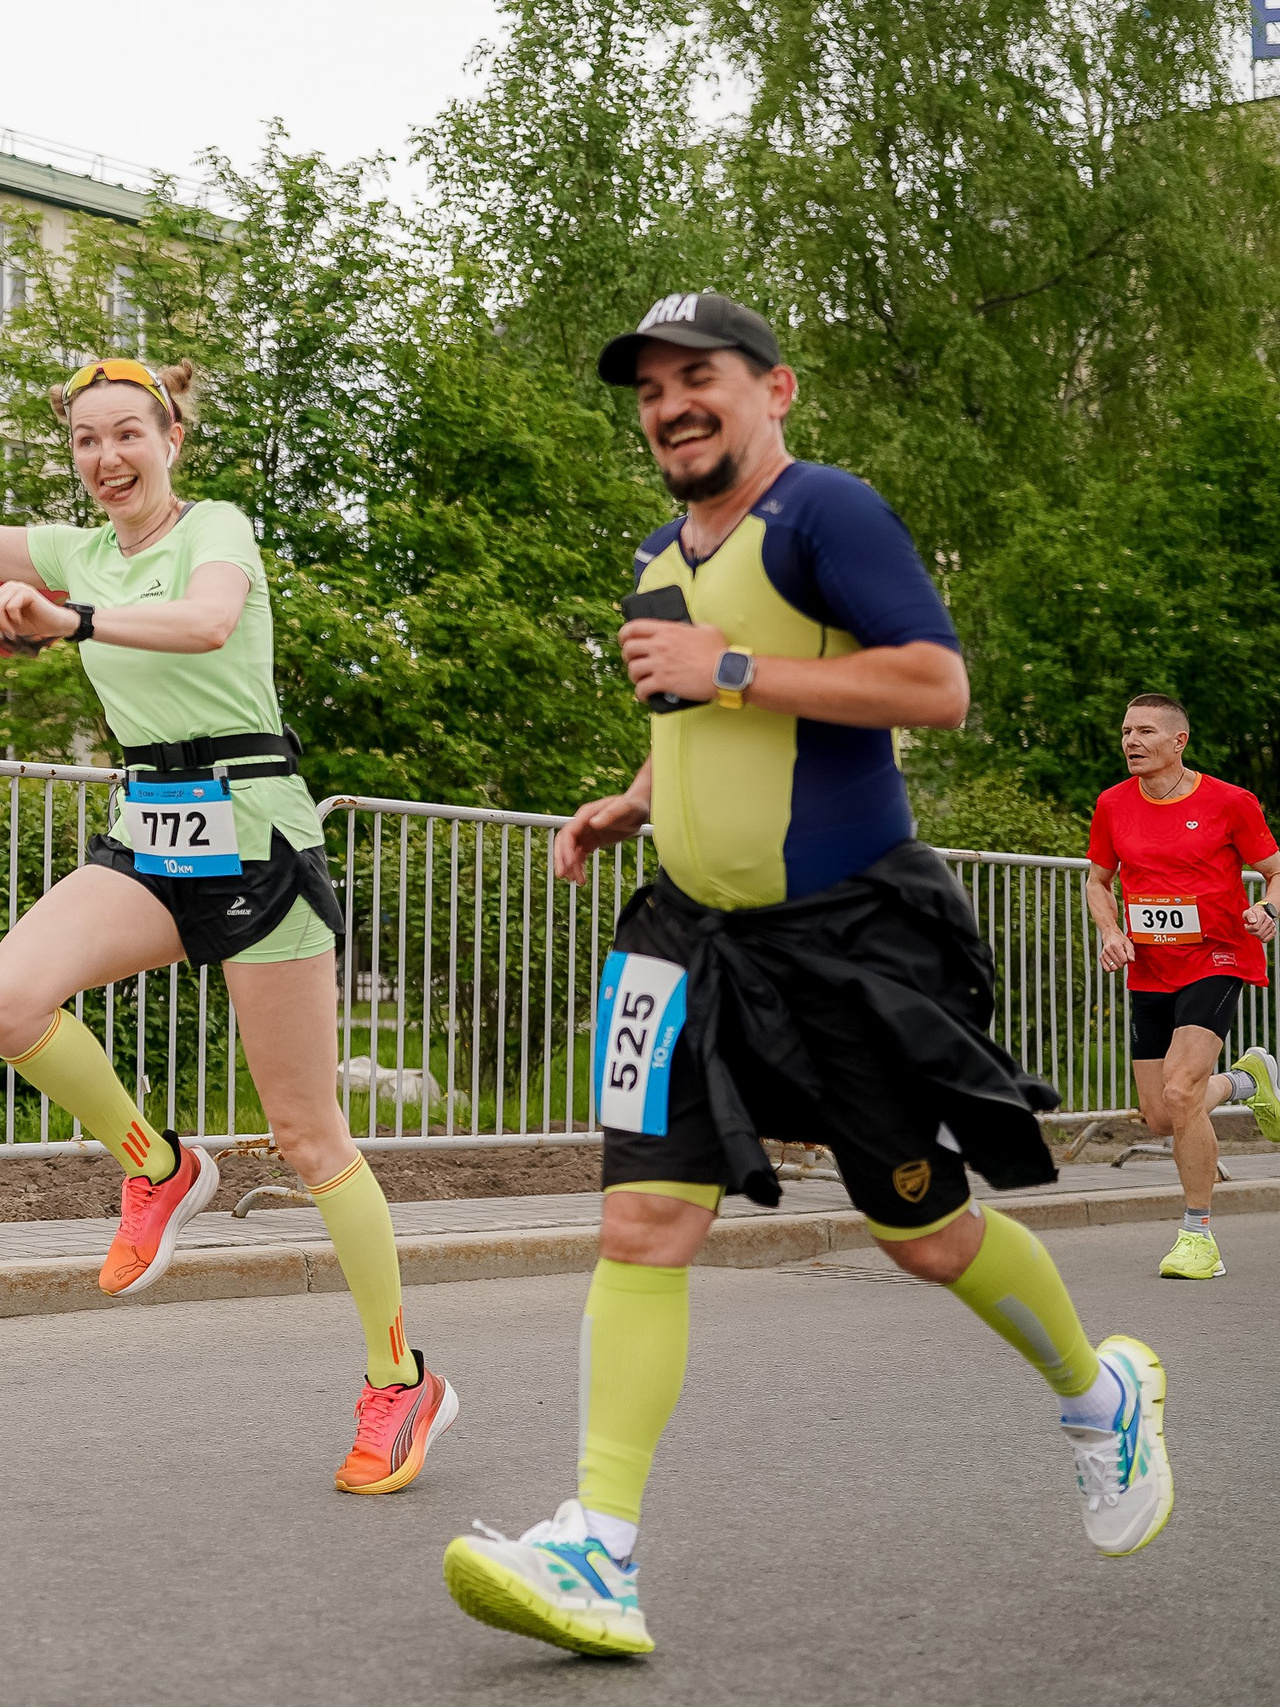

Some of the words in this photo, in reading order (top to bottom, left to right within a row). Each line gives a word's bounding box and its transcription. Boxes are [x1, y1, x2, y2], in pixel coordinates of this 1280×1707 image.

[140, 811, 210, 847] 772
[1141, 909, 1184, 929] 390
[609, 992, 655, 1092] 525
